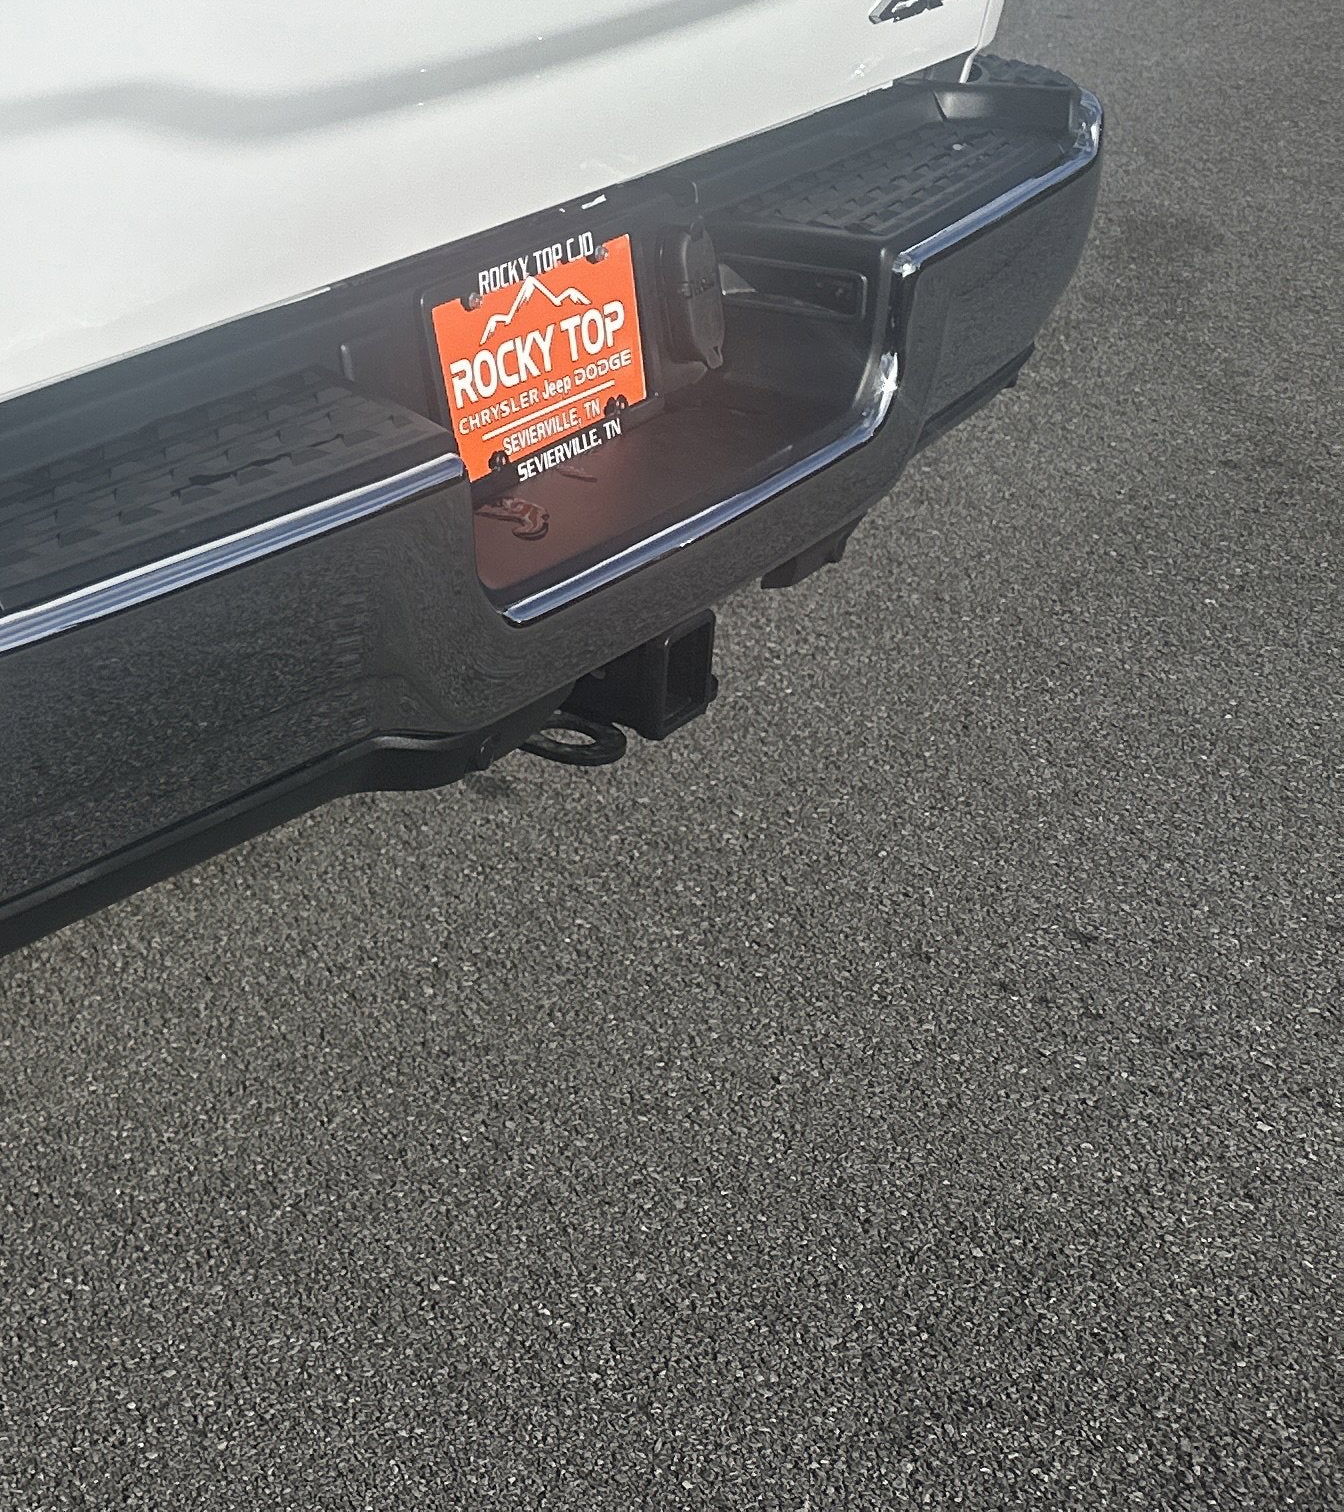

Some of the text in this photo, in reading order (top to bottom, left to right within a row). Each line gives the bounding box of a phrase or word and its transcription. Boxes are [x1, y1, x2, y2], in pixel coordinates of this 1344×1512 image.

[478, 231, 594, 296] ROCKY TOP CJD
[450, 300, 625, 409] ROCKY TOP
[458, 349, 632, 435] CHRYSLER Jeep DODGE
[502, 398, 602, 456] SEVIERVILLE, TN
[517, 417, 622, 482] SEVIERVILLE, TN
